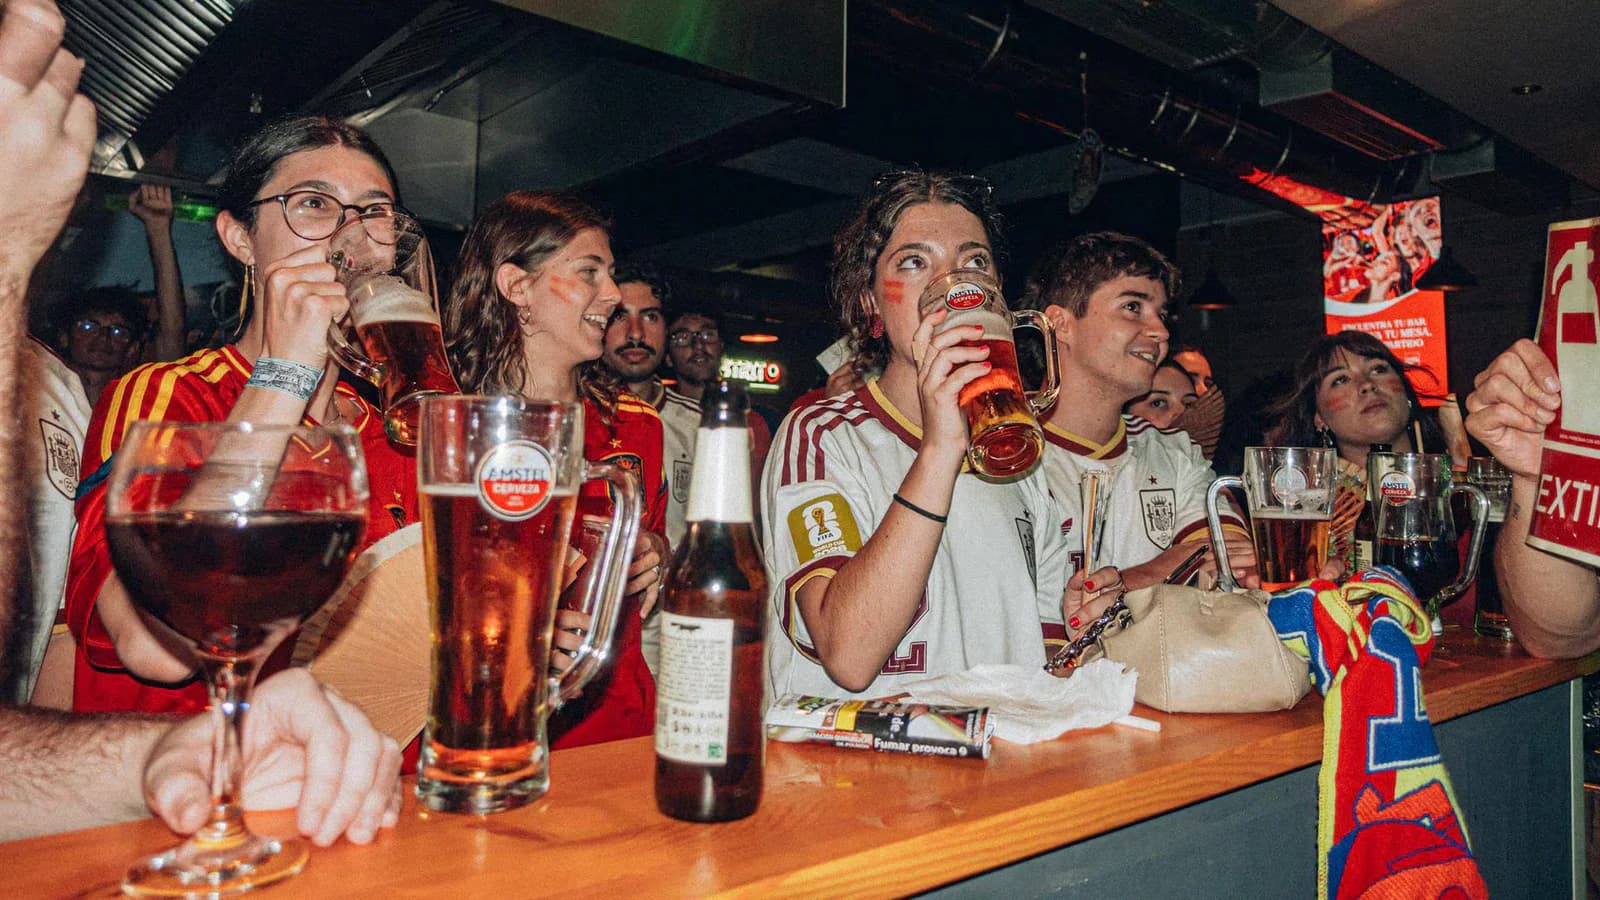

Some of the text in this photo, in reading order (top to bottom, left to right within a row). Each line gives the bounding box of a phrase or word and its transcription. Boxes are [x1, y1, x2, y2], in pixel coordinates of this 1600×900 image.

[1385, 329, 1398, 339] TU
[488, 468, 544, 481] AMSTEL
[492, 483, 540, 495] CERVEZA
[1536, 473, 1600, 529] EXTI
[817, 533, 834, 541] FIFA
[874, 737, 910, 751] Fumar
[911, 742, 957, 757] provoca
